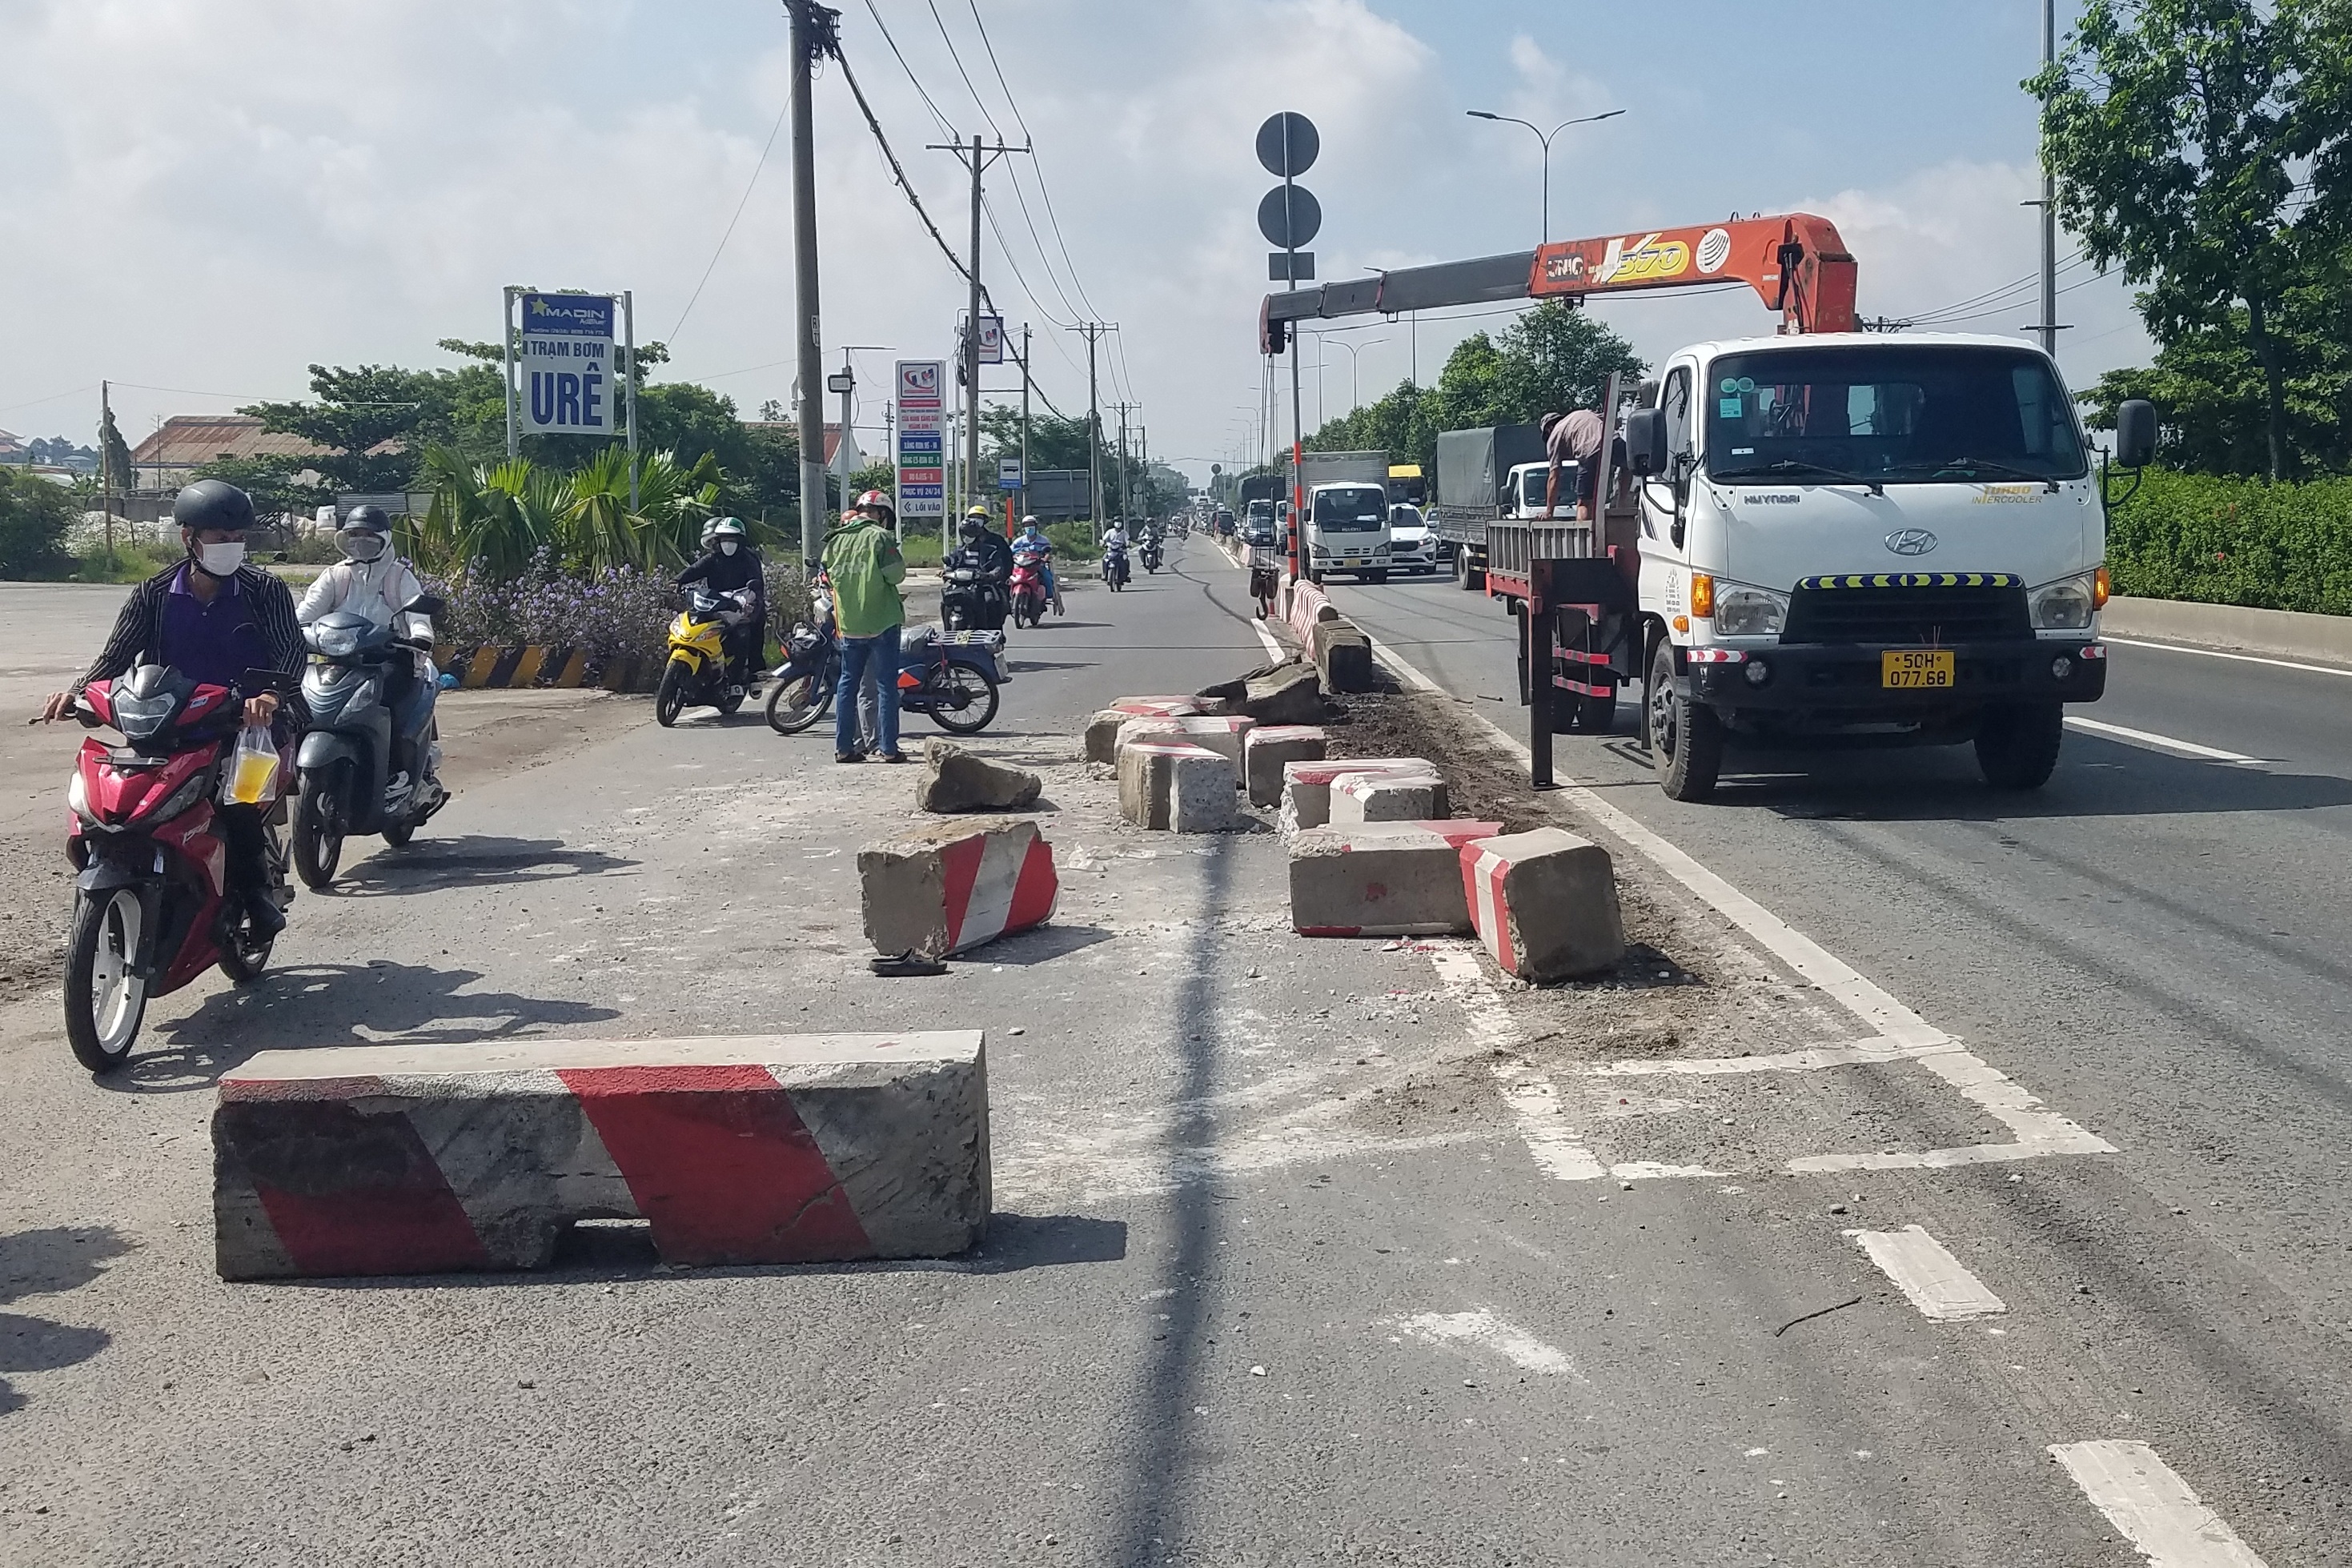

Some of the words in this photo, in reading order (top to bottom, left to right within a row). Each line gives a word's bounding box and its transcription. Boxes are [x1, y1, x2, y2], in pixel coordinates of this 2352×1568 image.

[545, 307, 604, 319] MADIN
[531, 341, 569, 359] TRẠM
[573, 342, 604, 358] BƠM
[531, 362, 603, 426] URÊ
[925, 487, 941, 495] 24/24
[915, 501, 926, 511] LỐI
[928, 502, 941, 511] VÀO
[1903, 653, 1935, 668] 50H
[1890, 670, 1947, 686] 077.68
